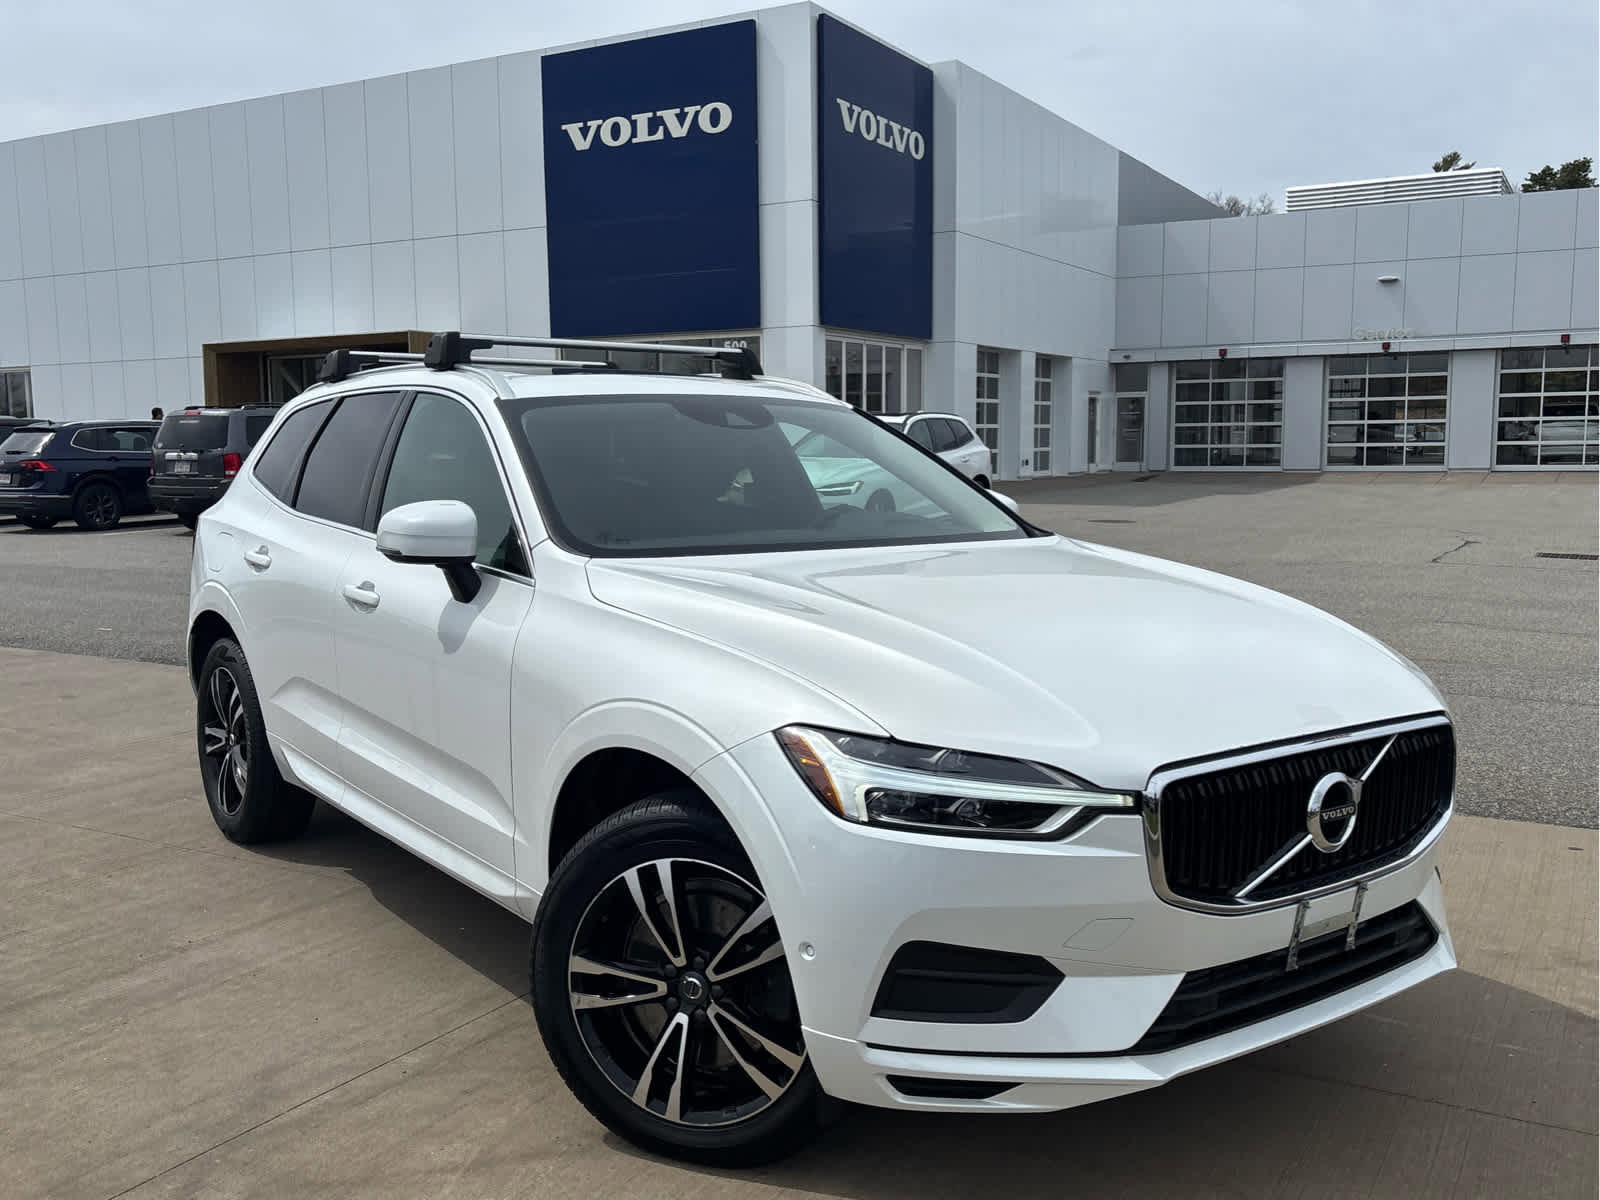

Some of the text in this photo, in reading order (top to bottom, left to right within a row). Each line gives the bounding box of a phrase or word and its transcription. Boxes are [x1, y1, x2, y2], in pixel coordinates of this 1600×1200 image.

[561, 101, 733, 152] VOLVO
[836, 97, 925, 161] VOLVO
[1322, 806, 1355, 820] VOLVO
